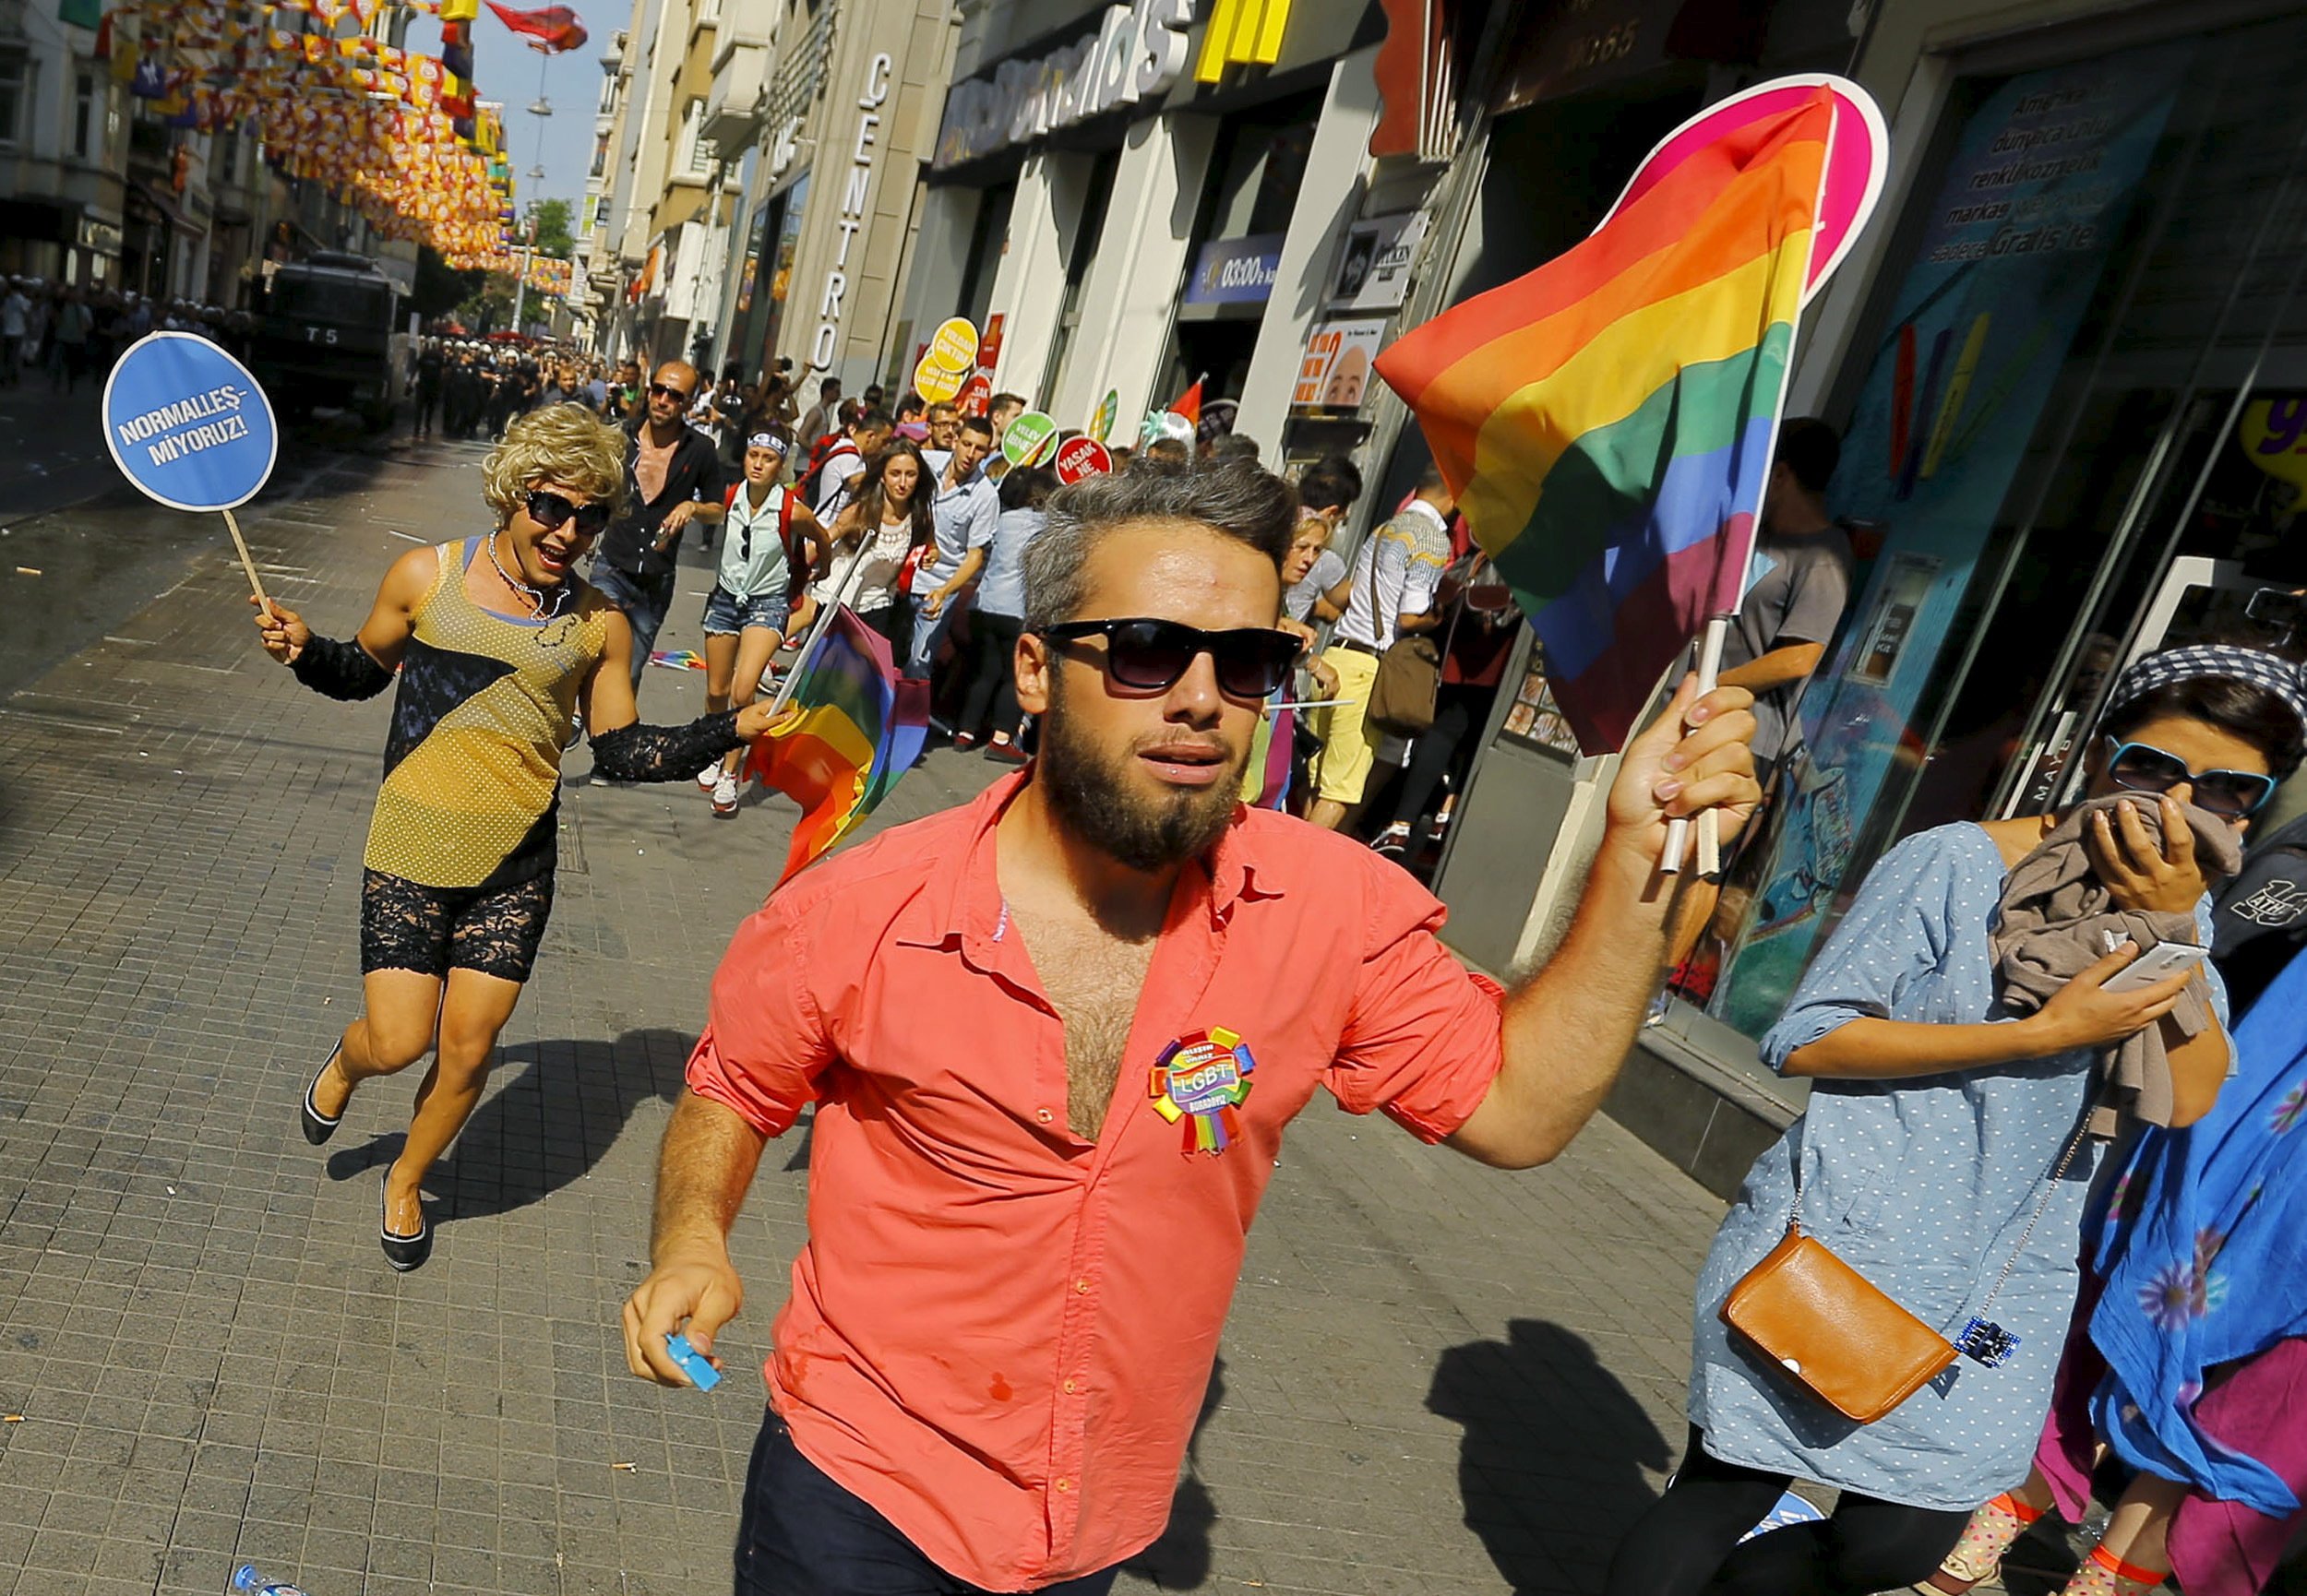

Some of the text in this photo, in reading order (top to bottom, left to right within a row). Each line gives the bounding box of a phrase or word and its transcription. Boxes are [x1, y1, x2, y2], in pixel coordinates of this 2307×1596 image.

[306, 327, 338, 344] T 5
[118, 385, 247, 446] NORMALLEŞ-
[148, 415, 248, 467] MİYORUZ!
[1059, 442, 1097, 472] YASAK
[1076, 459, 1095, 477] NE
[1181, 1064, 1229, 1093] LGBT
